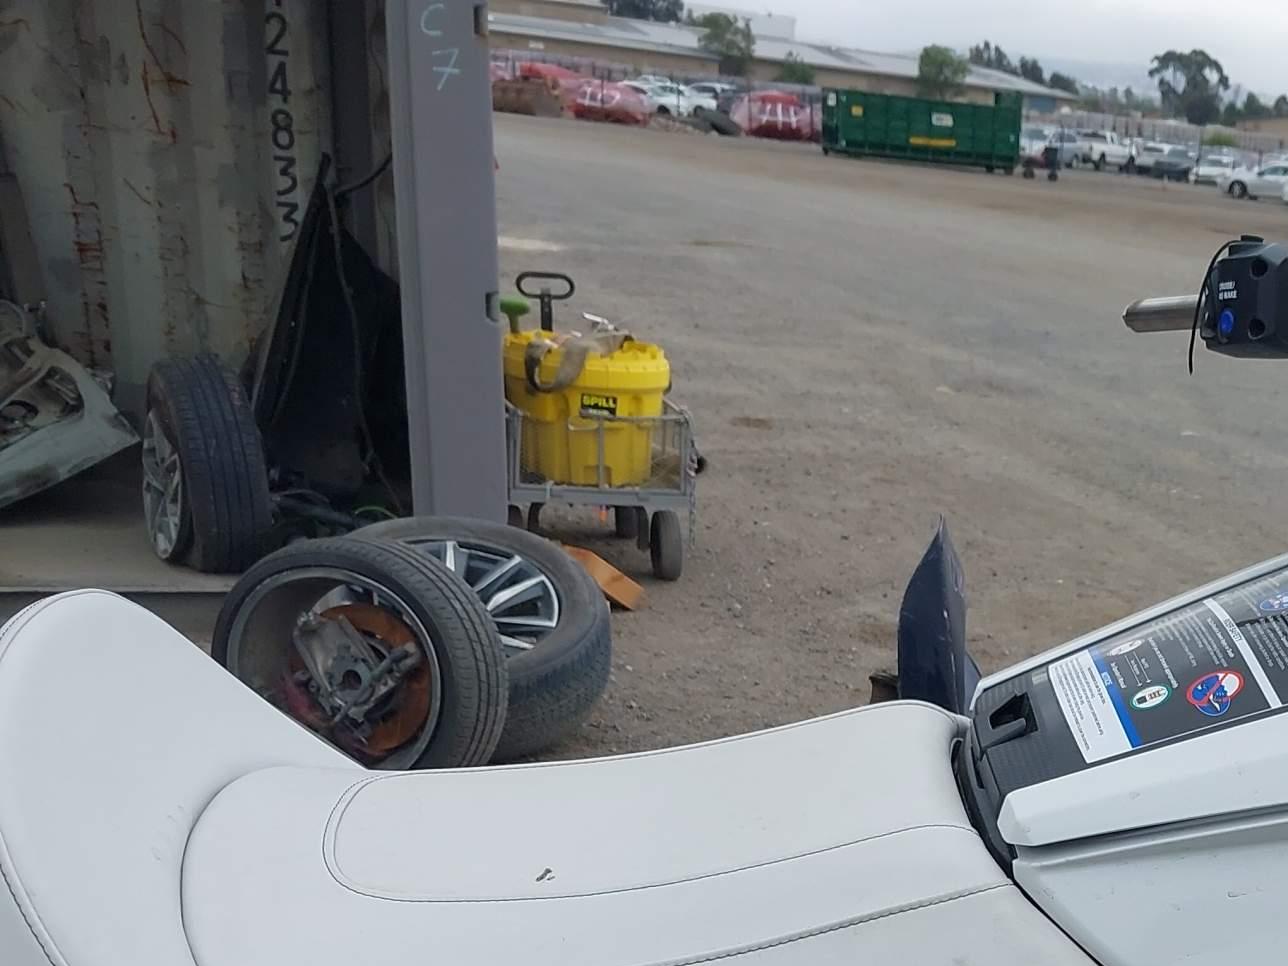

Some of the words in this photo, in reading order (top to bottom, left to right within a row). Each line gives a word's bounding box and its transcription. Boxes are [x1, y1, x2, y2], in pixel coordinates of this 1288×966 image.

[420, 2, 446, 36] C
[430, 47, 461, 92] 7
[264, 0, 301, 243] 24833
[583, 394, 616, 408] SPILL
[1230, 628, 1243, 641] SAFETY
[1101, 671, 1113, 686] NOTICE
